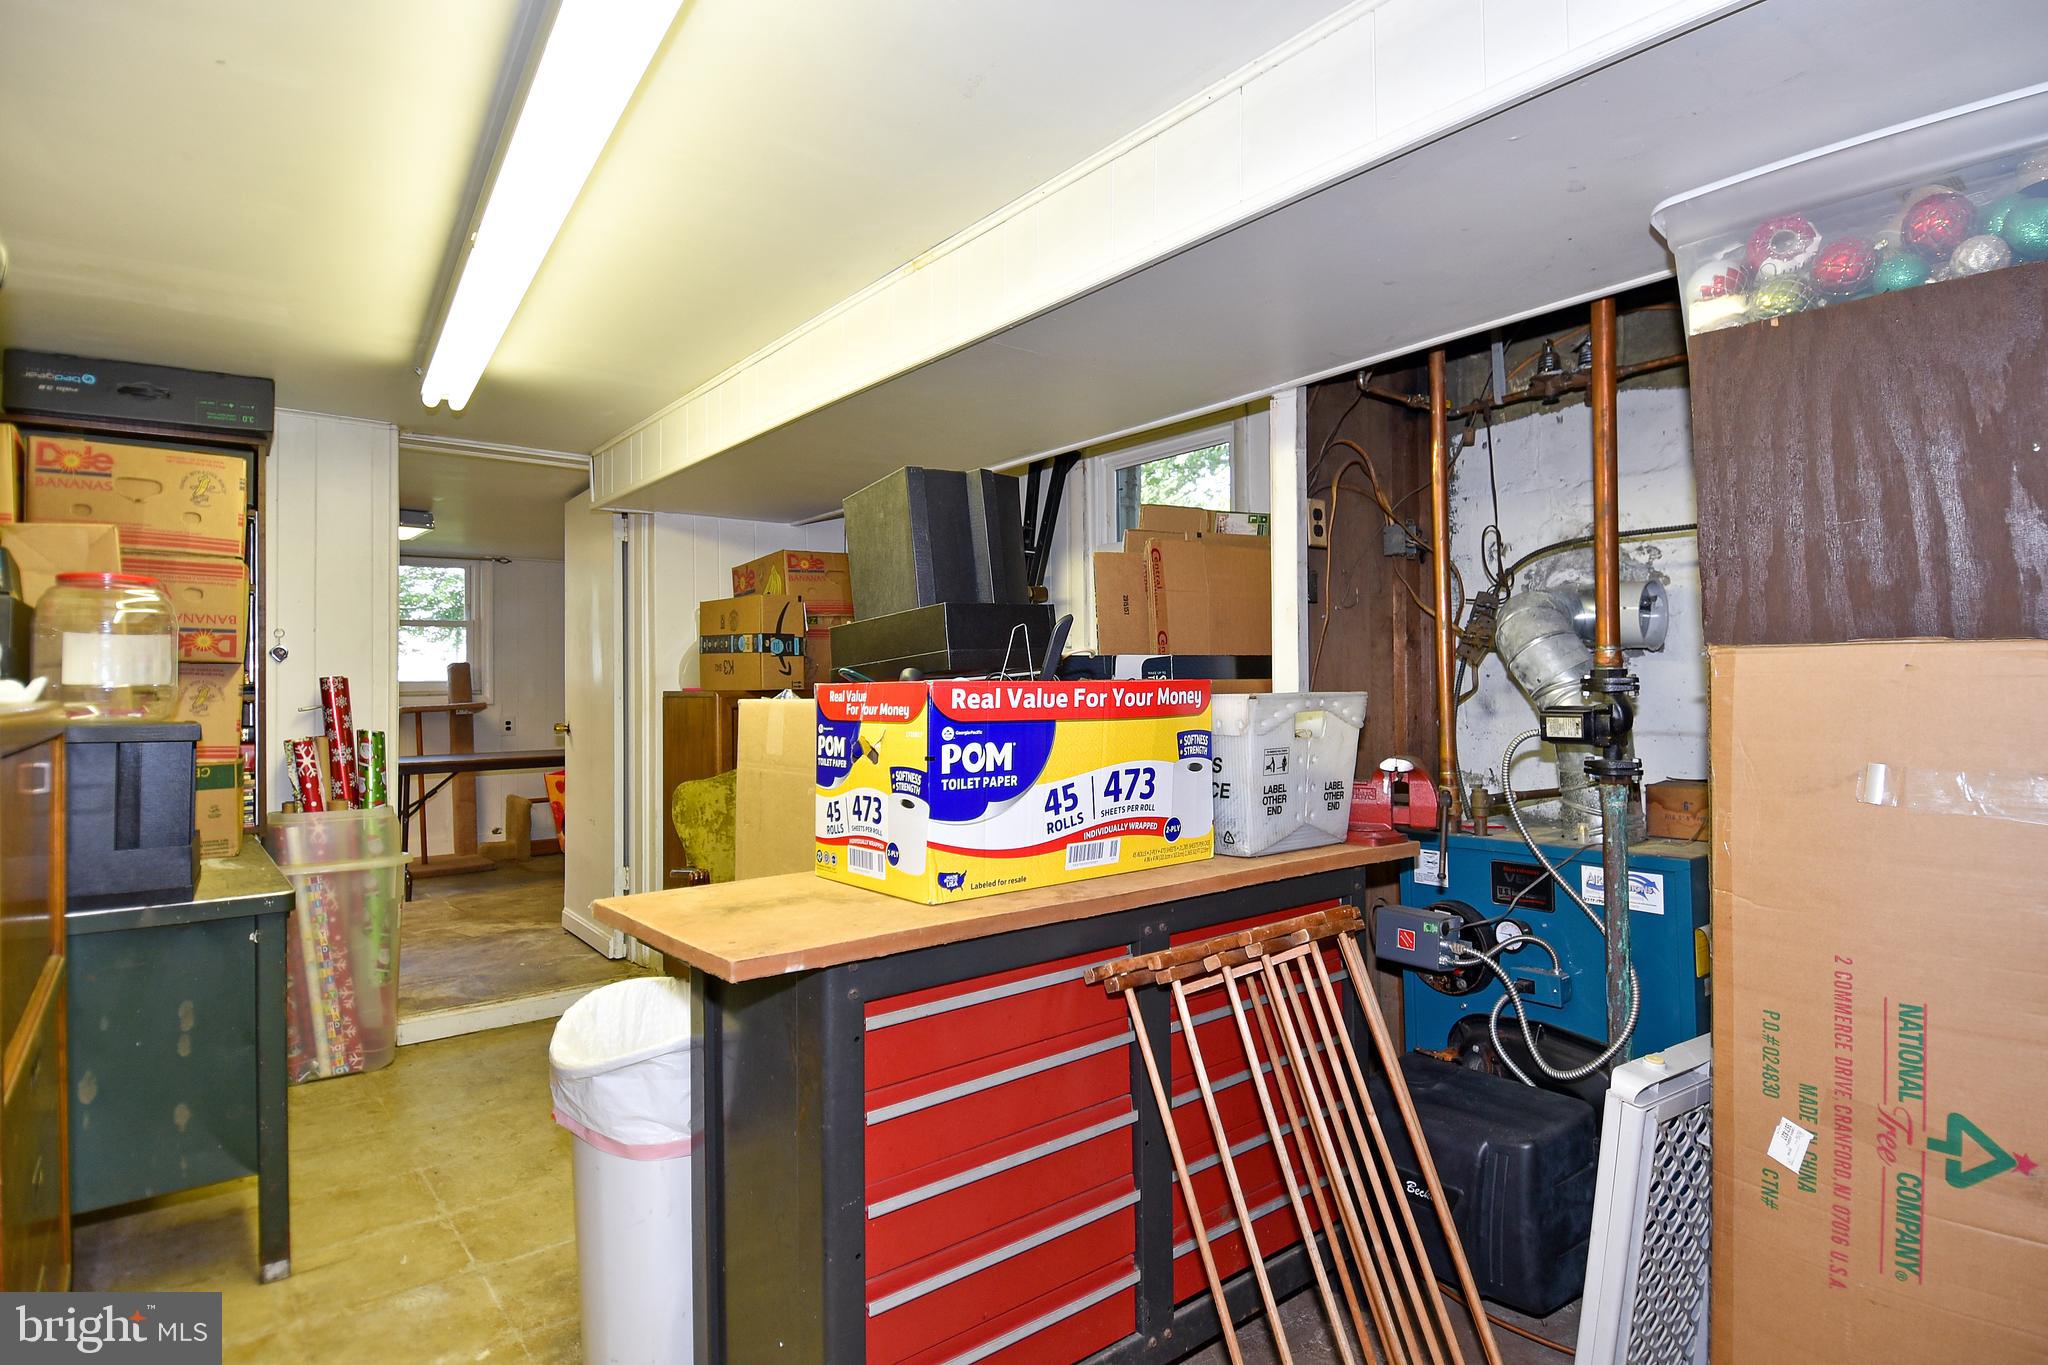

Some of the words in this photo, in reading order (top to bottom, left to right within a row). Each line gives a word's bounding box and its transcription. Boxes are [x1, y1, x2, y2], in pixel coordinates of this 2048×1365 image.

[35, 441, 114, 472] Dole
[35, 476, 113, 491] BANANAS
[787, 553, 825, 569] Dole
[1151, 548, 1162, 590] Central
[177, 614, 236, 624] BANANA
[829, 690, 846, 702] Real
[846, 690, 867, 702] Value
[951, 688, 1001, 710] Real
[1010, 688, 1068, 709] Value
[1074, 688, 1108, 708] For
[1112, 688, 1154, 707] Your
[1157, 688, 1202, 708] Money
[846, 704, 860, 716] For
[879, 704, 910, 719] Money
[818, 735, 846, 758] POM
[1184, 734, 1209, 746] SOFTNESS
[941, 742, 1013, 775] POM
[1184, 746, 1208, 756] STRENGTH
[832, 759, 847, 768] PAPER
[895, 770, 922, 786] SOFTNESS
[941, 777, 982, 791] TOILET
[983, 776, 1018, 788] PAPER
[1104, 767, 1156, 803] 473
[1324, 780, 1344, 791] LABEL
[896, 782, 921, 796] STRENGTH
[1263, 784, 1287, 794] LABEL
[1324, 790, 1344, 801] OTHER
[1044, 782, 1079, 816] 45
[1262, 794, 1288, 806] OTHER
[1327, 801, 1340, 811] END
[826, 800, 841, 822] 45
[852, 795, 882, 825] 473
[1100, 806, 1126, 818] SHEETS
[1126, 804, 1139, 814] PER
[1140, 803, 1156, 812] ROLL
[1267, 806, 1282, 816] END
[826, 823, 844, 835] ROLLS
[1046, 812, 1084, 834] ROLLS
[1084, 824, 1128, 840] INDIVIDUALLY
[1128, 822, 1158, 832] WRAPPED
[1165, 824, 1181, 835] 2-PLY
[970, 878, 996, 890] Labeled
[997, 878, 1006, 886] for
[1008, 876, 1027, 884] resale
[1834, 955, 1853, 966] 2
[1834, 970, 1853, 1052] COMMERCE
[1898, 1003, 1924, 1103] NATIONAL
[1799, 1082, 1818, 1126] MADE
[1876, 1104, 1914, 1167] Tree
[1798, 1152, 1818, 1194] CHINA
[1760, 1168, 1779, 1210] CTN#
[1831, 1204, 1850, 1247] 07016
[1895, 1172, 1922, 1277] COMPANY
[1828, 1250, 1848, 1289] U.S.A.
